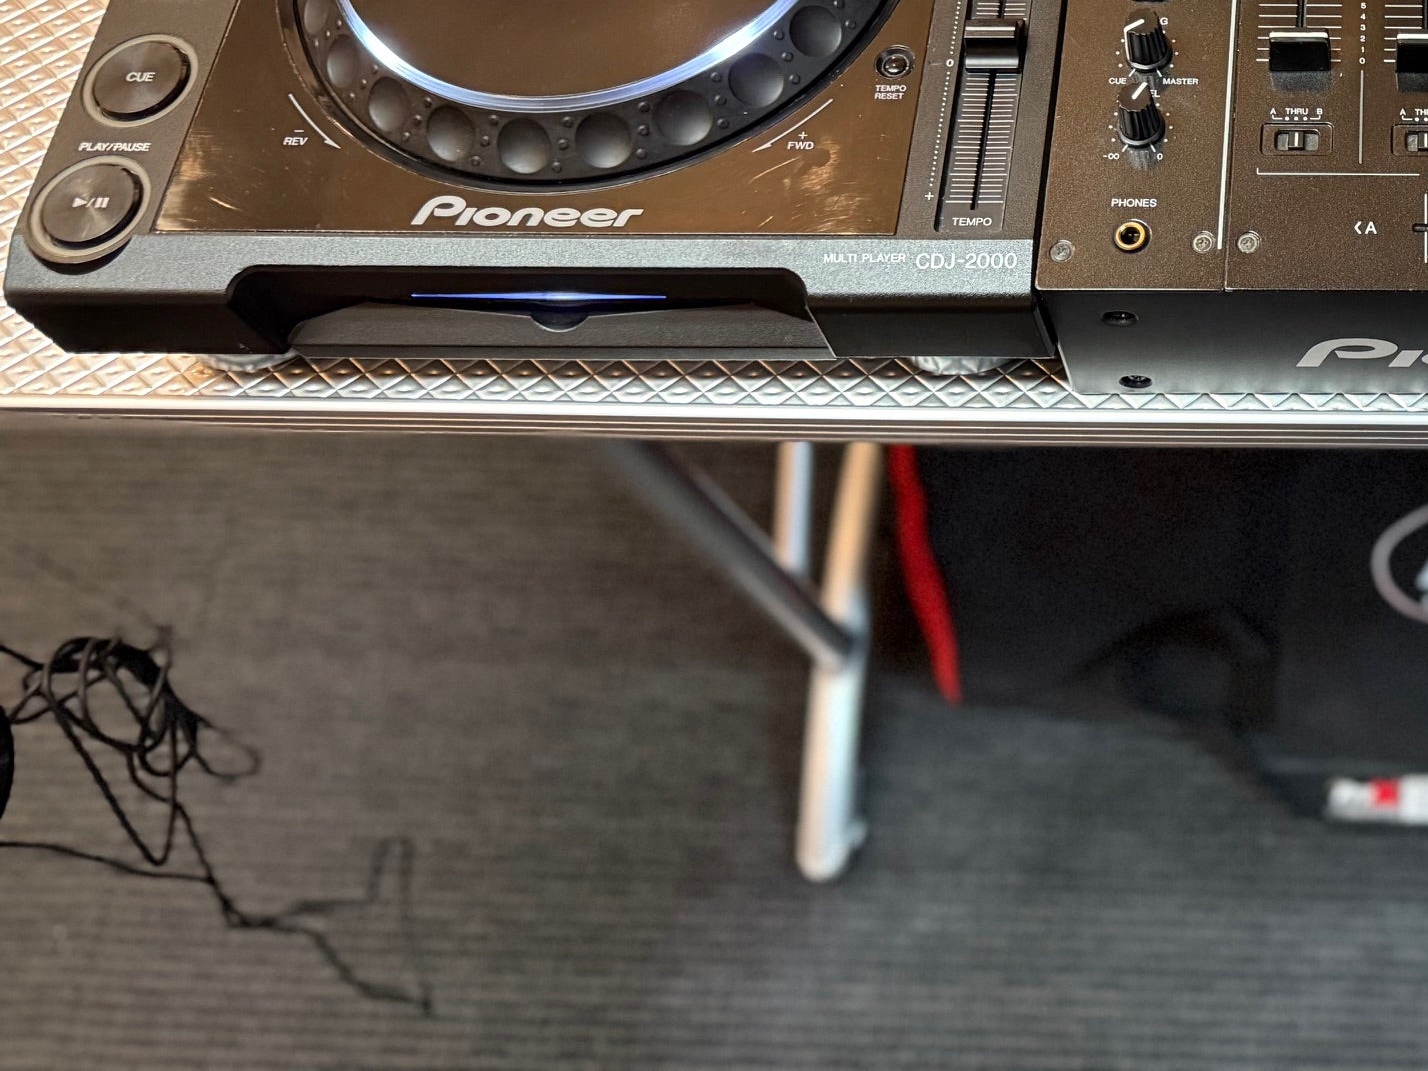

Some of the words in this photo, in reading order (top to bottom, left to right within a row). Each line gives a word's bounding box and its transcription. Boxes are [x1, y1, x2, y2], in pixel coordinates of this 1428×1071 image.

[126, 72, 155, 82] CUE
[875, 85, 906, 93] TEMPO
[874, 92, 904, 100] RESET
[283, 137, 307, 146] REV
[787, 140, 814, 150] FWD
[79, 142, 151, 152] PLAY/PAUSE
[1111, 198, 1157, 207] PHONES
[410, 195, 644, 228] Pioneer
[952, 217, 992, 226] TEMPO
[824, 254, 856, 263] MULTI
[862, 254, 906, 263] PLAYER
[916, 252, 1017, 269] CDJ-2000
